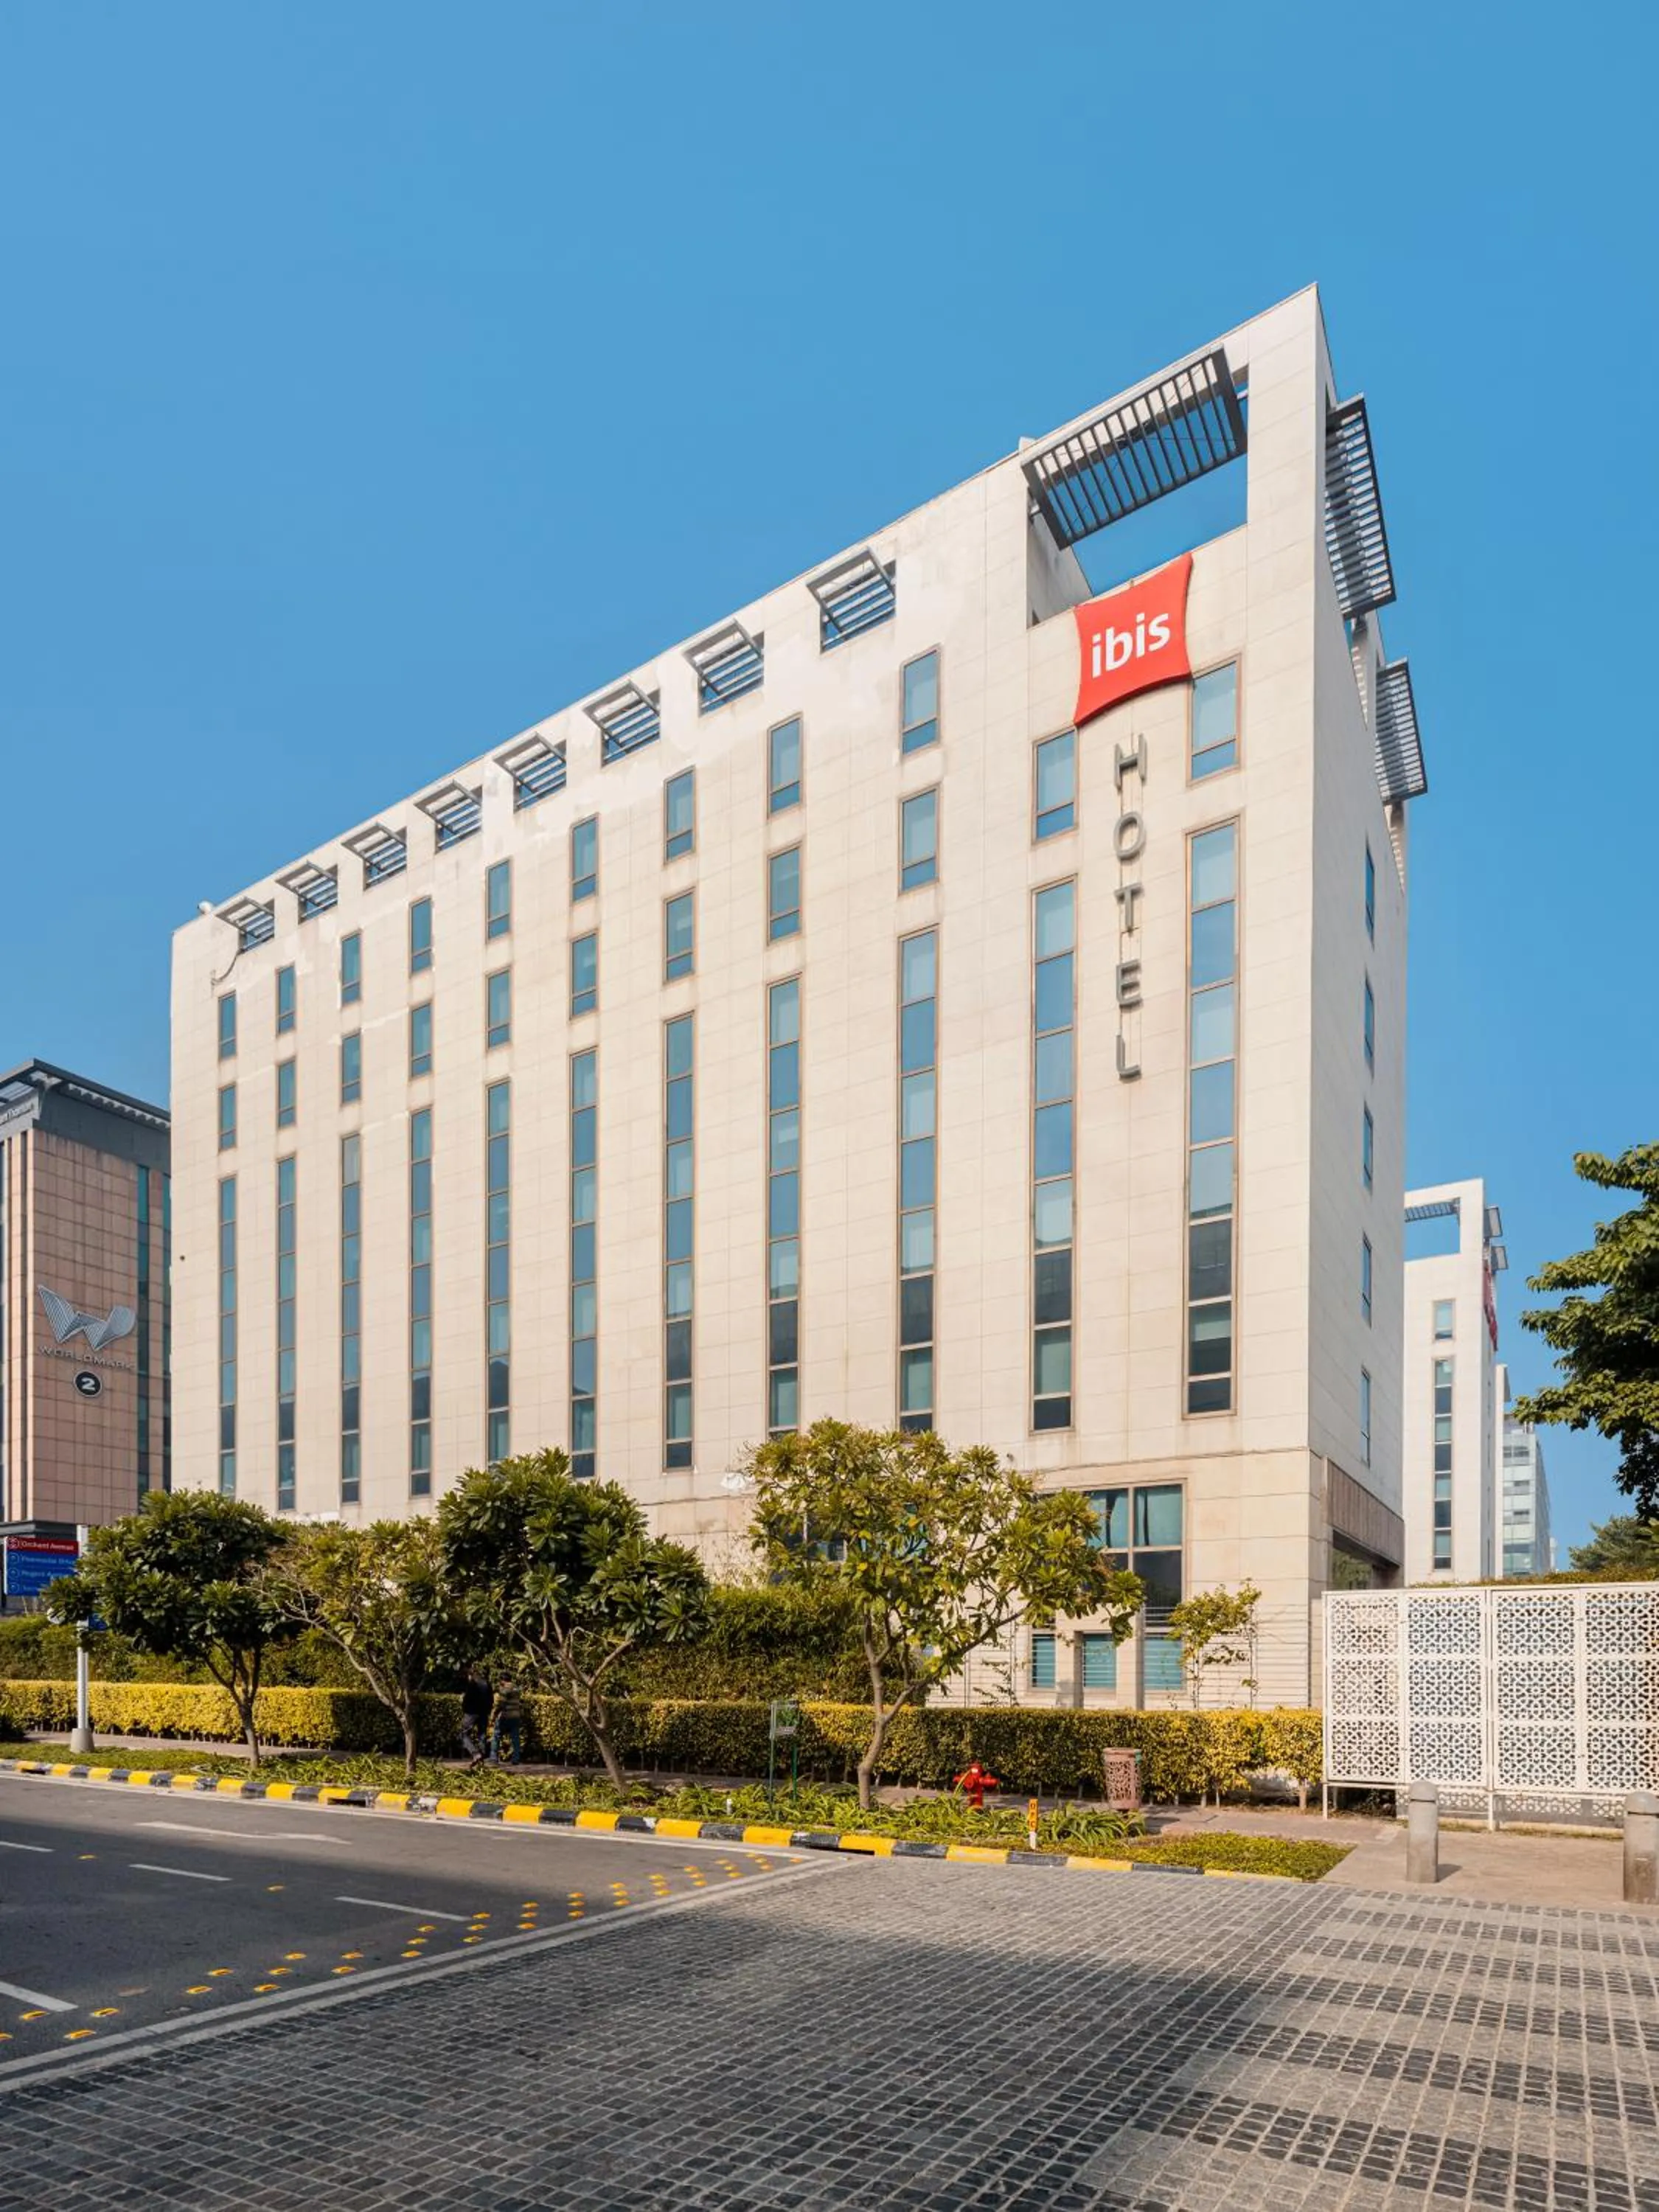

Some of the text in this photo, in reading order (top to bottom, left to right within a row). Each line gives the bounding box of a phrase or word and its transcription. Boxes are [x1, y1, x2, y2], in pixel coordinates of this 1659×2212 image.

[1092, 613, 1170, 679] ibis
[1113, 733, 1147, 1082] HOTEL
[81, 1377, 96, 1391] 2
